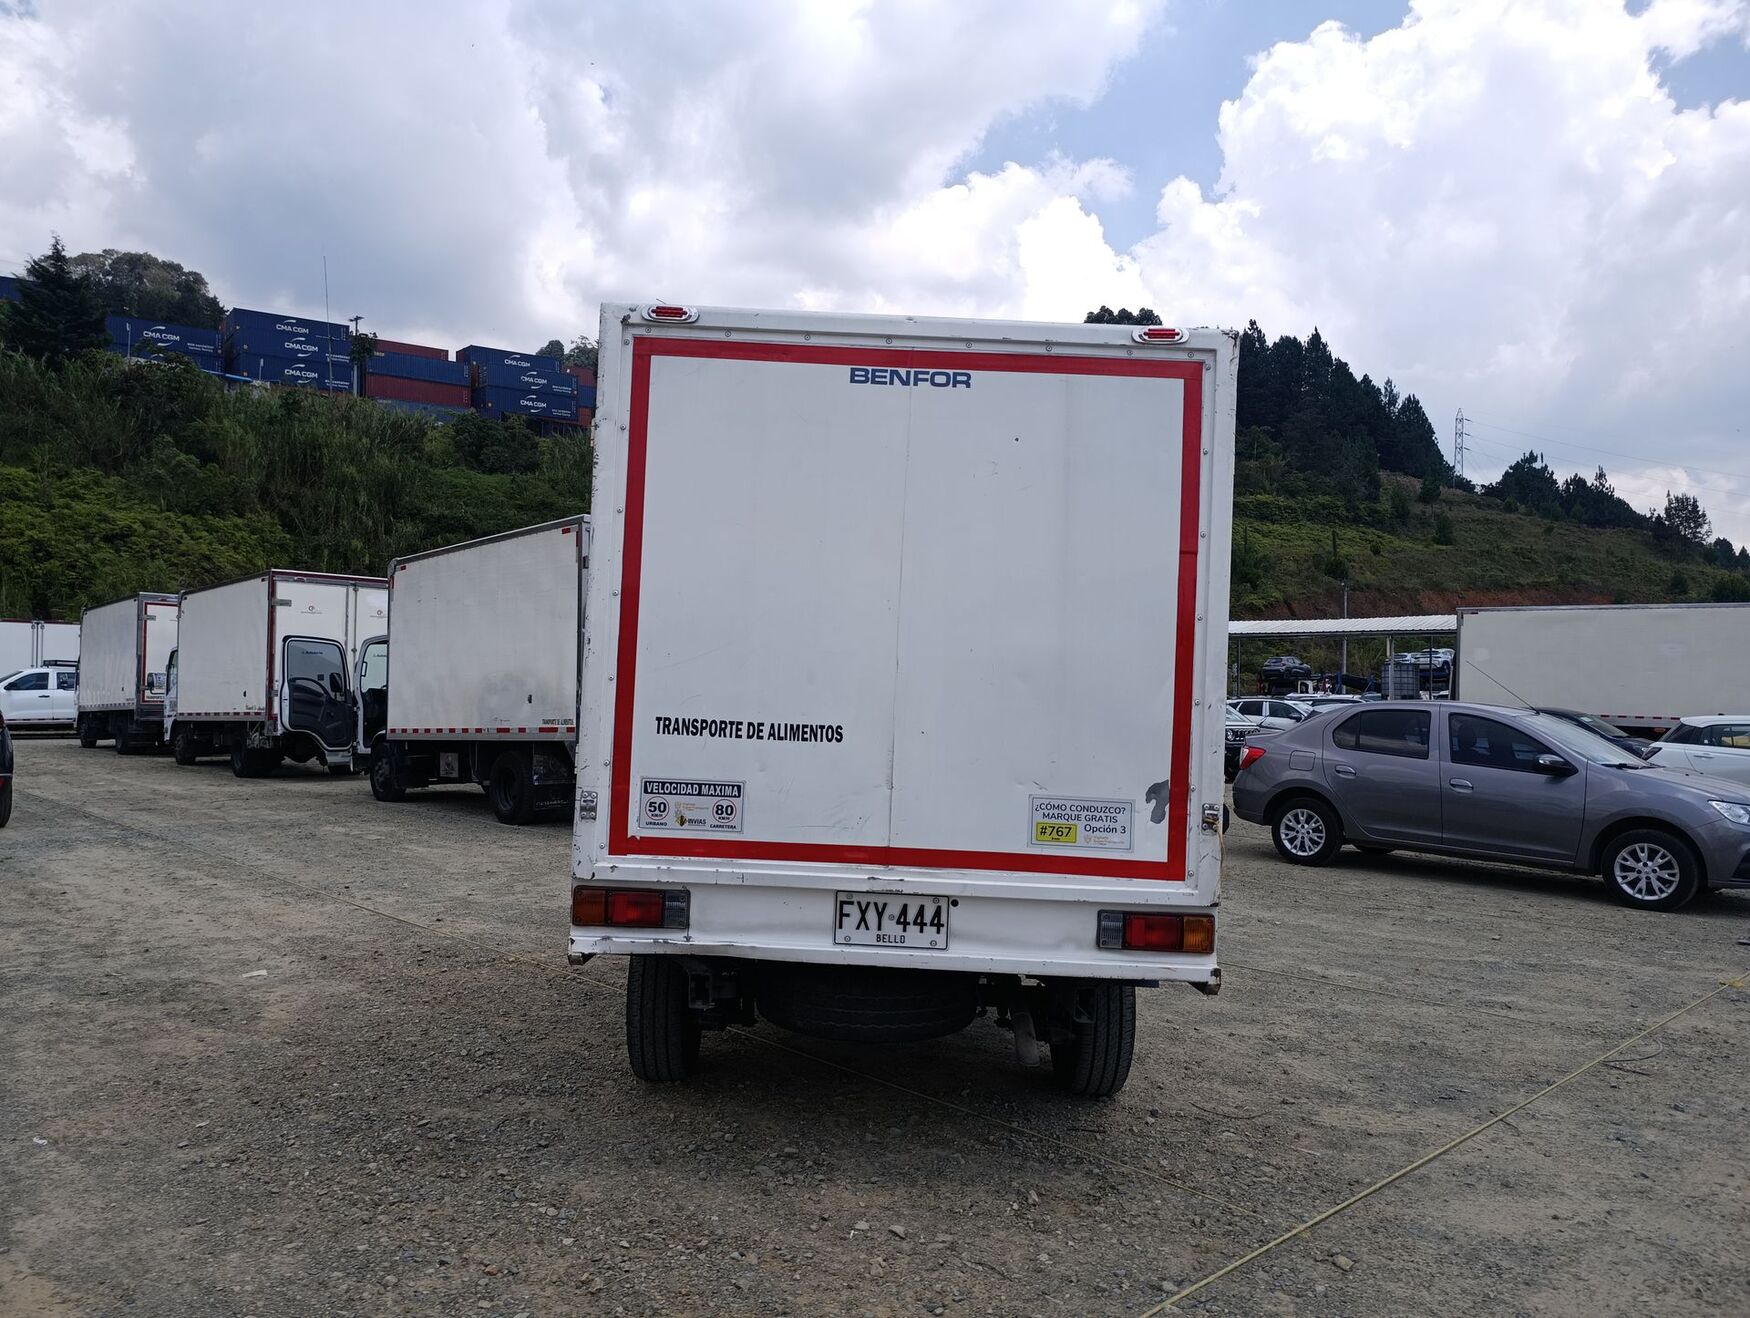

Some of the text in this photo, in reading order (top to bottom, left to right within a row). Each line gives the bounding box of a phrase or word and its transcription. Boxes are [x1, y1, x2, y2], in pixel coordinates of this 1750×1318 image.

[276, 323, 309, 335] CMA CGM
[143, 330, 180, 342] CMA CGM
[284, 341, 319, 352] CMA CGM
[504, 358, 517, 367] CMA
[284, 368, 318, 379] CMA CGM
[850, 367, 972, 389] BENFOR
[520, 399, 547, 409] CMA CGM
[655, 716, 844, 743] TRANSPORTE DE ALIMENTOS
[646, 782, 739, 797] VELOCIDAD MAXIMA
[648, 801, 667, 814] 50
[715, 804, 734, 816] 80
[1069, 804, 1126, 815] CONDUZCO?
[1042, 811, 1118, 824] MARQUE GRATIS
[1040, 825, 1073, 837] #767
[1083, 823, 1127, 835] Opción 3
[838, 900, 945, 935] FXY 444
[876, 933, 906, 944] BELLO
